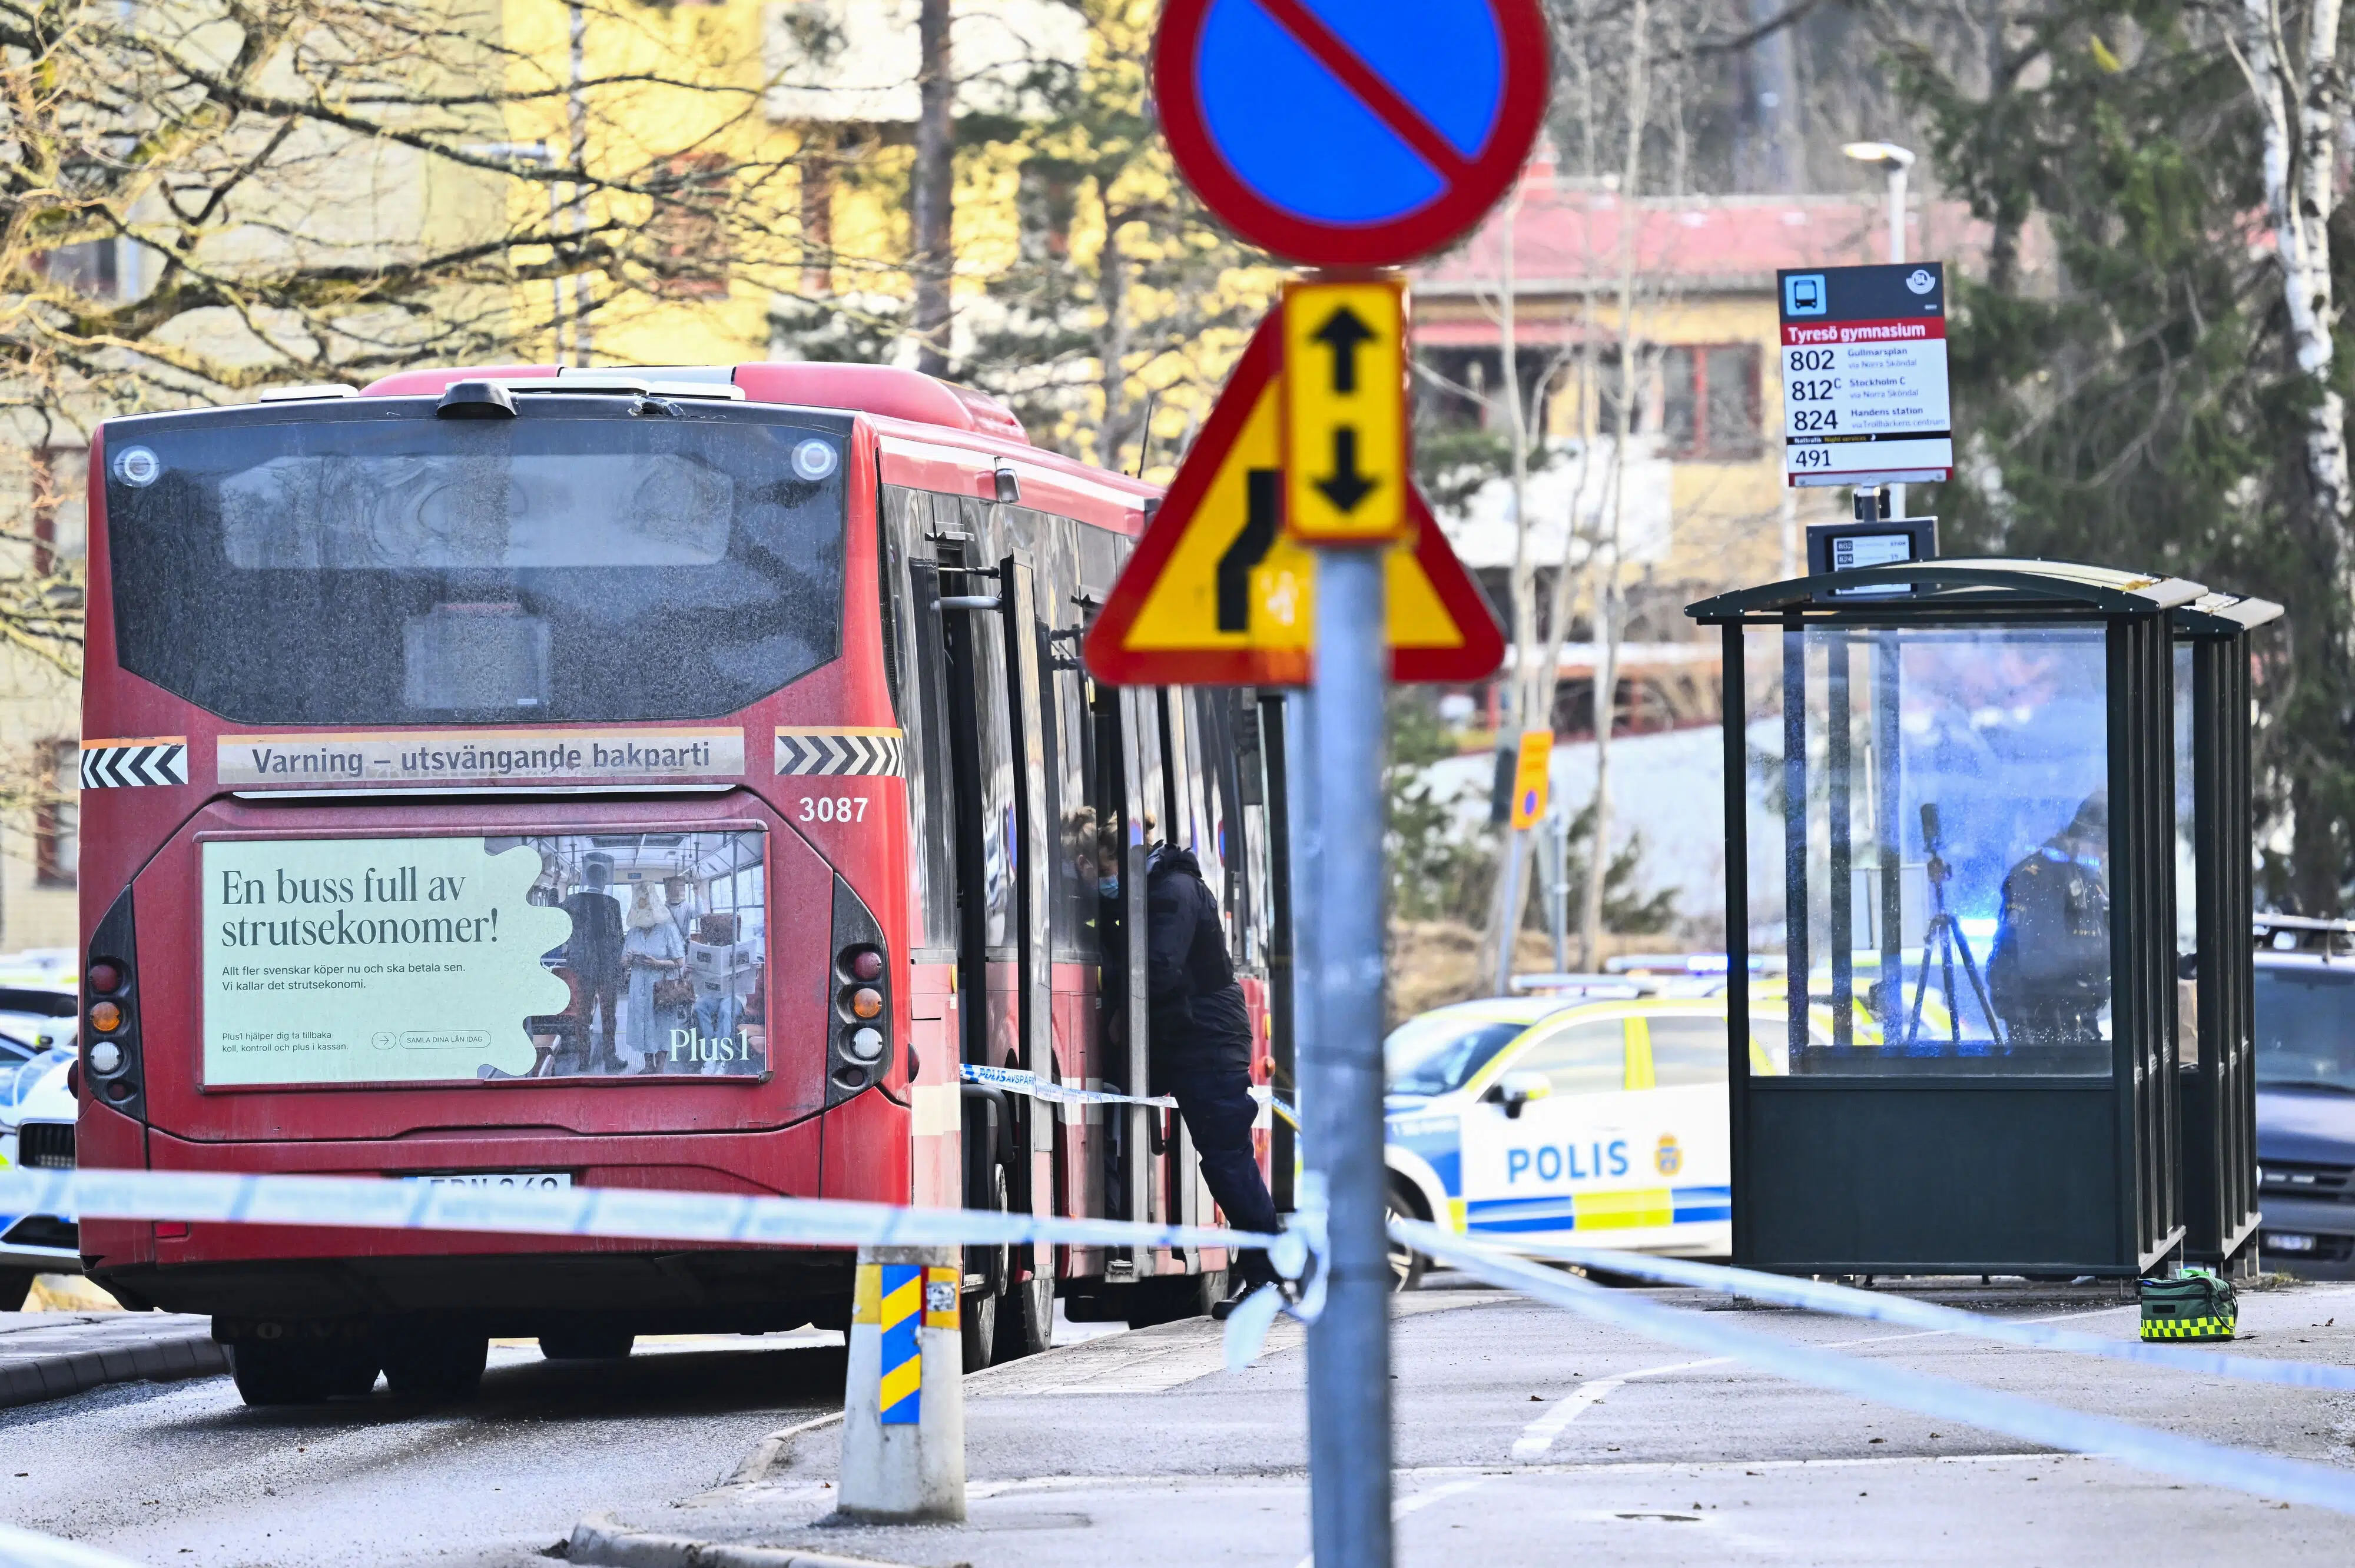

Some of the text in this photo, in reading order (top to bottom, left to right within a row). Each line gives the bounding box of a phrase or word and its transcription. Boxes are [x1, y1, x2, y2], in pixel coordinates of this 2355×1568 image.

[1787, 323, 1926, 345] Tyresö gymnasium
[1790, 350, 1835, 371] 802
[1847, 348, 1908, 357] Gullmarsplan
[1849, 376, 1906, 387] Stockholm C
[1794, 409, 1838, 431] 824
[1851, 407, 1923, 417] Handens station
[1796, 449, 1832, 467] 491
[251, 748, 363, 778] Varning
[402, 743, 582, 776] utsvängande
[593, 741, 709, 770] bakparti
[799, 797, 868, 822] 3087
[221, 866, 466, 905] En buss full av
[221, 908, 498, 946] strutsekonomer!
[222, 963, 466, 976] Allt fler svenskar köper nu och ska betala sen.
[222, 979, 366, 991] Vi kallar det strutsekonomi.
[223, 1031, 331, 1041] Plus1 hjälper dig ta tillbaka
[451, 1035, 465, 1043] LÅN
[669, 1027, 750, 1062] Plus1
[222, 1045, 238, 1053] koll,
[241, 1044, 271, 1052] kontroll
[293, 1043, 310, 1052] plus
[317, 1042, 349, 1051] kassan.
[978, 1067, 1006, 1082] POLIS
[1507, 1140, 1630, 1184] POLIS
